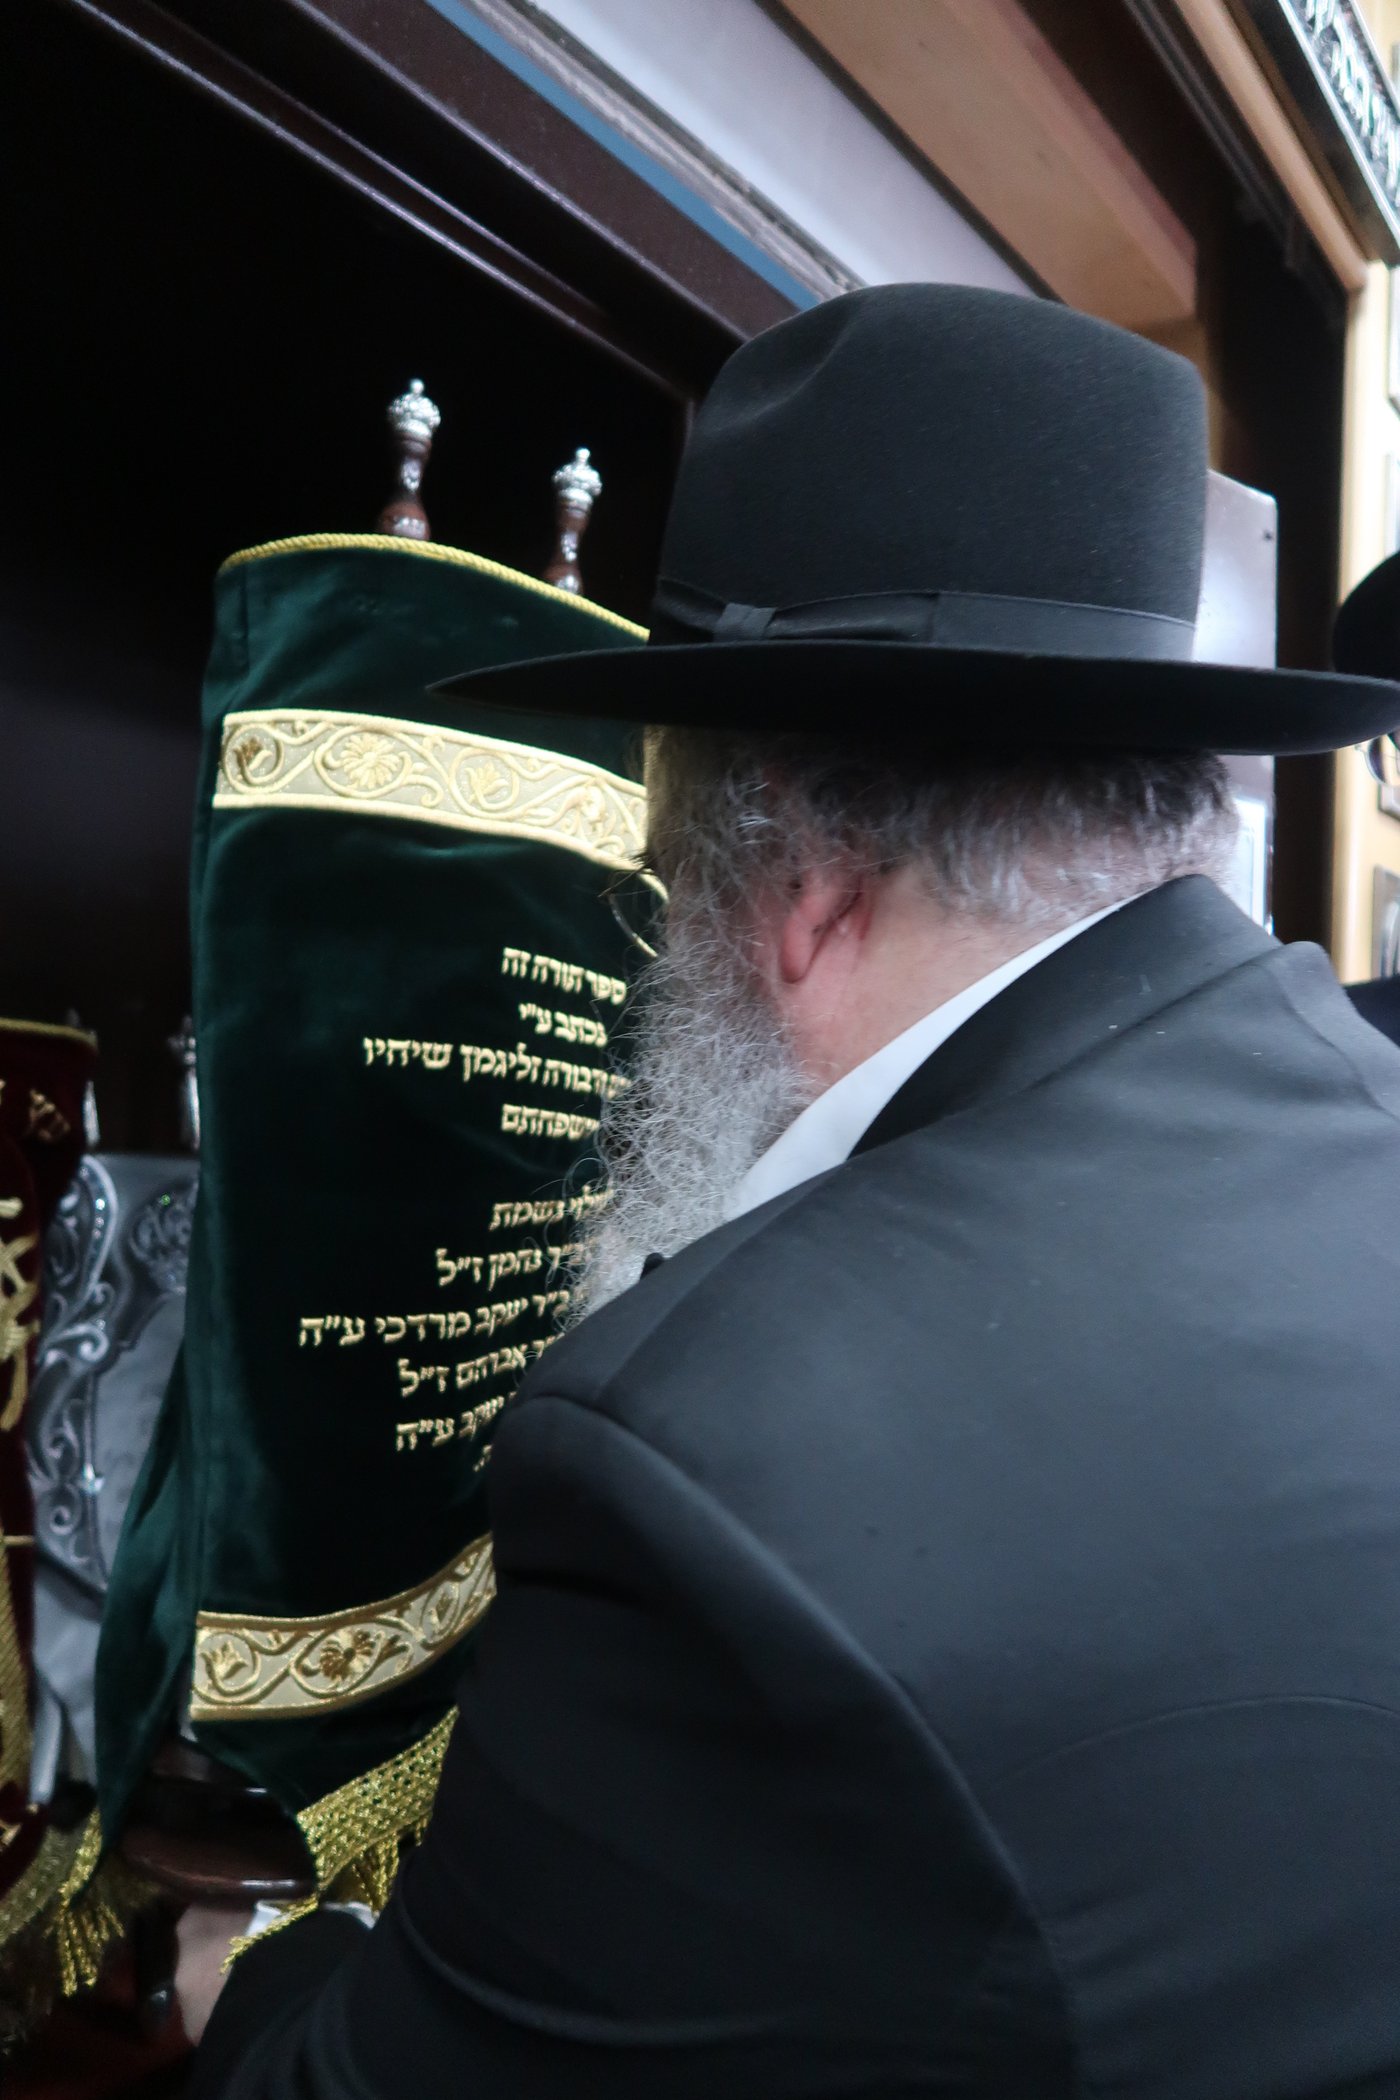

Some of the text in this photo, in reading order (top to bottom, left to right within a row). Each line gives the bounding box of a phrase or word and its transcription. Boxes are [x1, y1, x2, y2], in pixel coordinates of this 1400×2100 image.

[501, 947, 628, 1004] ספר תורה זה
[554, 1012, 607, 1047] נכתב
[459, 1042, 541, 1082] זליגמן
[489, 1199, 564, 1230] נשמת
[488, 1248, 541, 1290] נחמן
[375, 1311, 471, 1343] מרדכי
[474, 1298, 528, 1336] יעקב
[456, 1344, 528, 1389] אברהם
